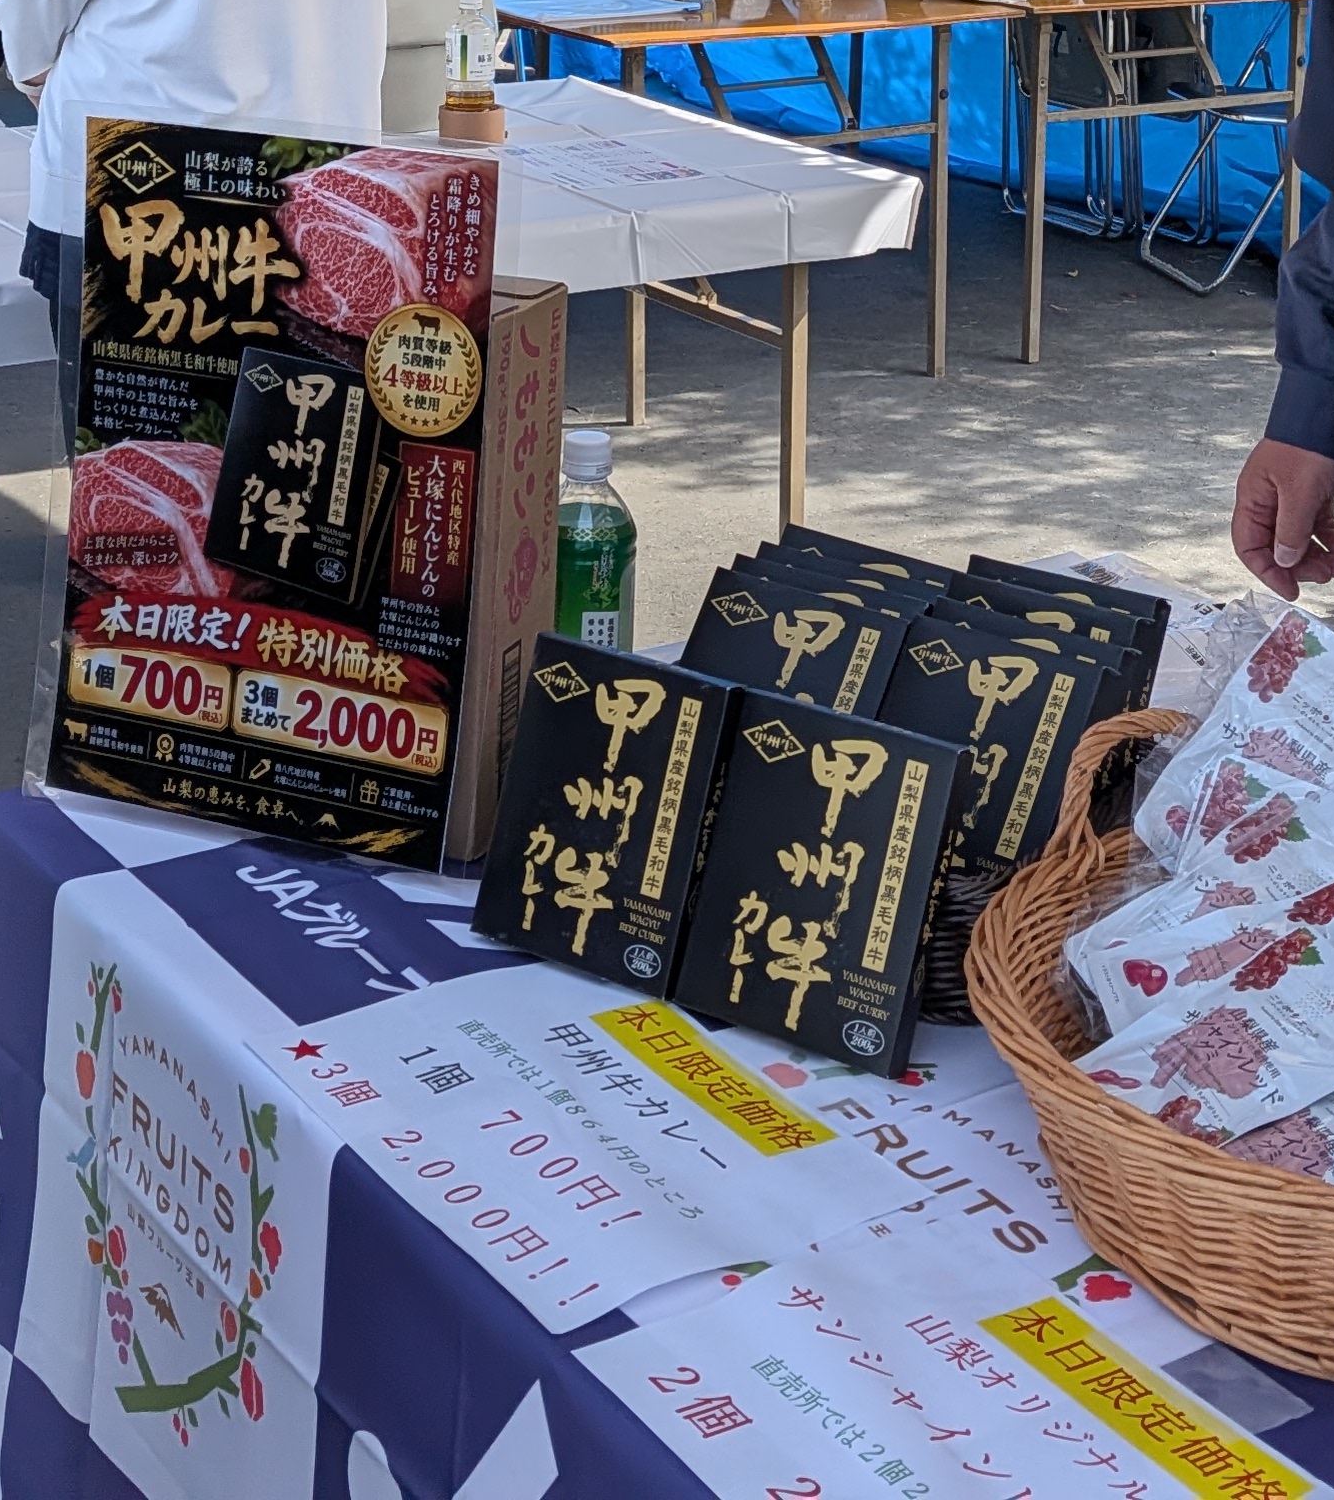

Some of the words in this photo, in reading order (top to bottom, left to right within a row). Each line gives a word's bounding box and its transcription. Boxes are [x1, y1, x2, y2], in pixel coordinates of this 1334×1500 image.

[117, 157, 162, 178] 甲州牛
[184, 174, 286, 200] 極上の味わい
[185, 150, 267, 176] 山梨が誇る
[100, 200, 301, 314] 甲州牛
[423, 194, 439, 304] とろける旨み。
[443, 177, 464, 283] 霜降りが生む
[463, 173, 481, 277] きめ細やかな
[93, 339, 238, 376] 山梨県産銘柄黒毛和牛使用
[133, 288, 279, 345] カレー
[397, 334, 453, 356] 肉質等級
[401, 352, 447, 372] 5段階中
[381, 364, 464, 398] 4等級以上
[402, 393, 440, 413] を使用
[239, 472, 265, 550] カレー
[264, 373, 337, 569] 甲州牛
[399, 464, 427, 575] ピューレ使用
[445, 458, 466, 567] 西八代地区特産
[420, 454, 448, 598] 大塚にんじんの
[94, 595, 252, 651] 本日限定!
[256, 616, 410, 695] 特別価格
[119, 654, 224, 716] 700円
[243, 679, 279, 708] 3個
[239, 706, 291, 733] まとめて
[292, 689, 439, 759] 2,000円
[999, 676, 1074, 856] 山梨県産銘柄黒毛和牛
[162, 776, 305, 827] 山梨の恵みを、食卓へ。
[553, 677, 667, 957] 甲州牛
[643, 701, 700, 893] 山梨県産銘柄黒毛和牛
[521, 823, 556, 931] カレー
[622, 896, 672, 922] YAMANASHI
[765, 739, 889, 1032] 甲州牛
[864, 763, 925, 966] 山梨県産銘柄黒毛和牛
[629, 910, 662, 931] WAGYU
[729, 890, 769, 1003] カレー
[836, 995, 858, 1013] BEEF
[858, 1001, 891, 1022] CURRY
[841, 968, 897, 997] YAMANASHI
[848, 984, 885, 1006] WAGYU
[119, 1034, 231, 1164] YAMANASHI
[310, 1061, 383, 1108] 3個
[456, 1017, 705, 1221] 直売所では1個864円のところ
[543, 1023, 728, 1170] 甲州牛カレー
[613, 1005, 817, 1150] 本日限定価格
[111, 1071, 235, 1234] FRUITS
[398, 1045, 476, 1095] 1個
[480, 1109, 643, 1228] 700円!
[817, 1097, 1049, 1254] FRUITS
[886, 1094, 1075, 1224] YAMANASHI
[108, 1129, 232, 1286] KINGDOM
[648, 1365, 754, 1440] 2個
[1003, 1306, 1289, 1500] 本日限定価格
